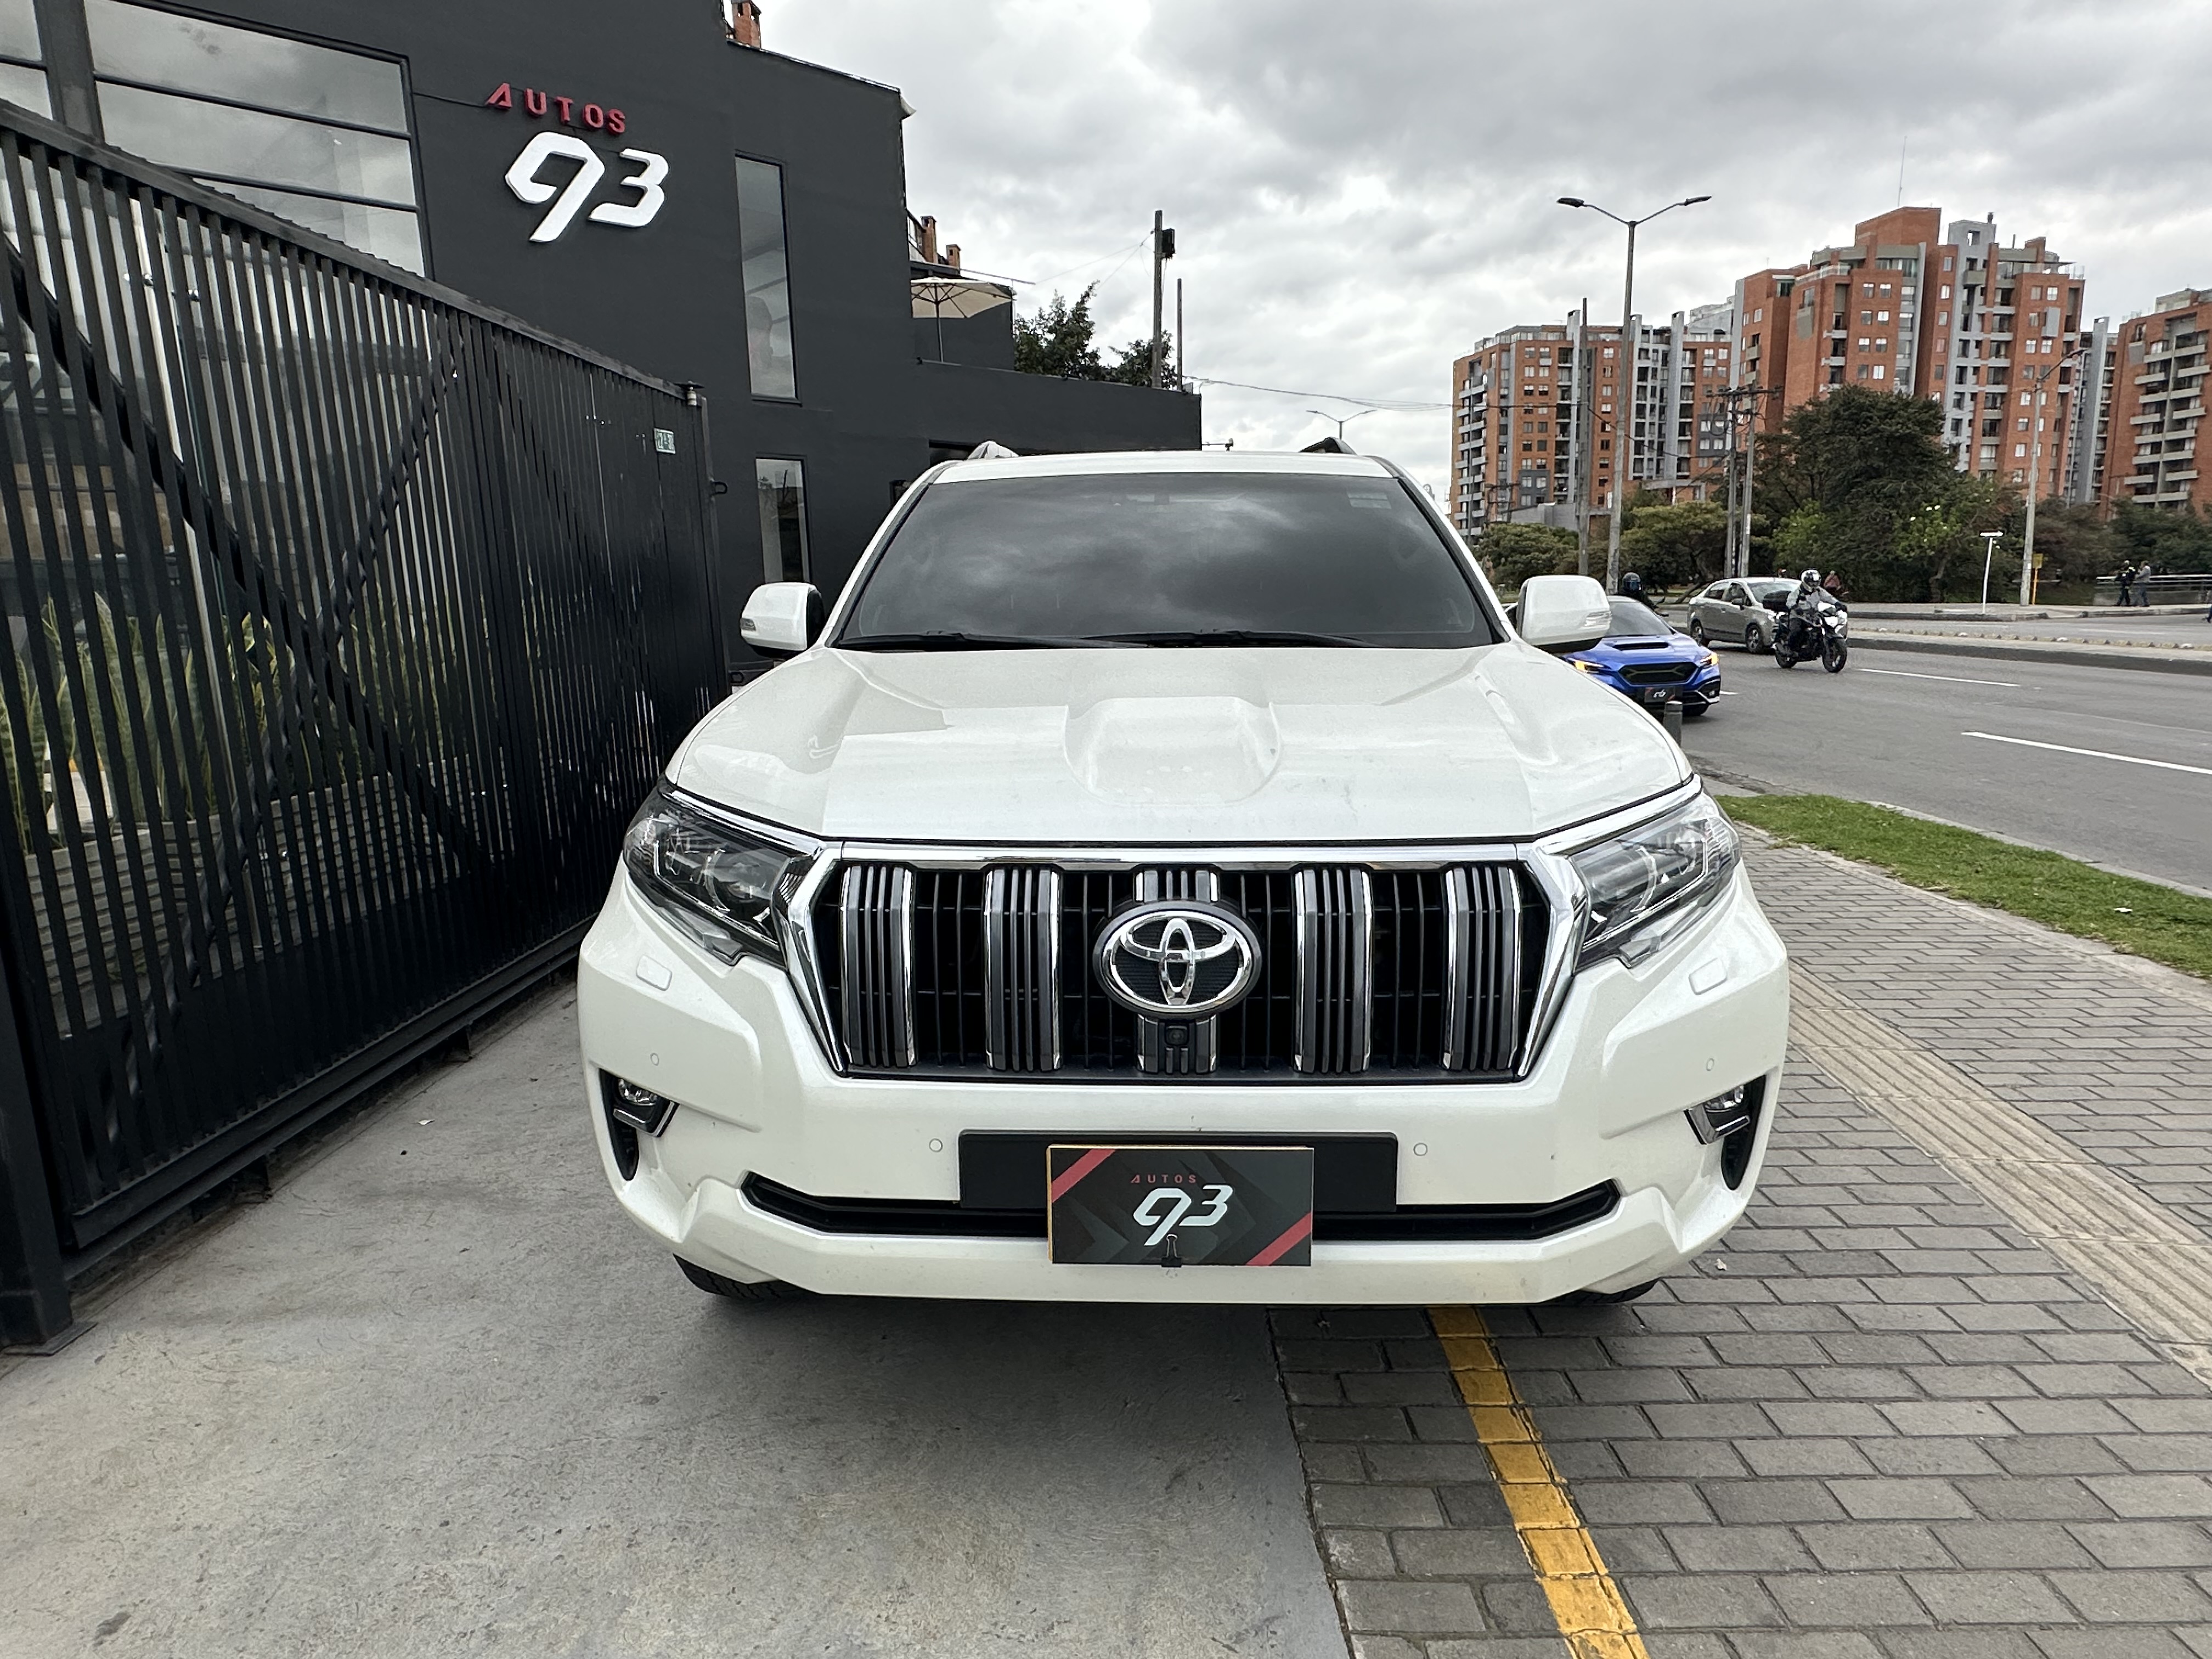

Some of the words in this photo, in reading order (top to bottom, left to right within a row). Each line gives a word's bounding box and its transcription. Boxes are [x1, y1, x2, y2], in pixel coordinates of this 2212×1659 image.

[486, 82, 626, 133] AUTOS
[505, 131, 669, 242] 93
[1130, 1174, 1197, 1184] AUTOS
[1133, 1184, 1233, 1246] 93
